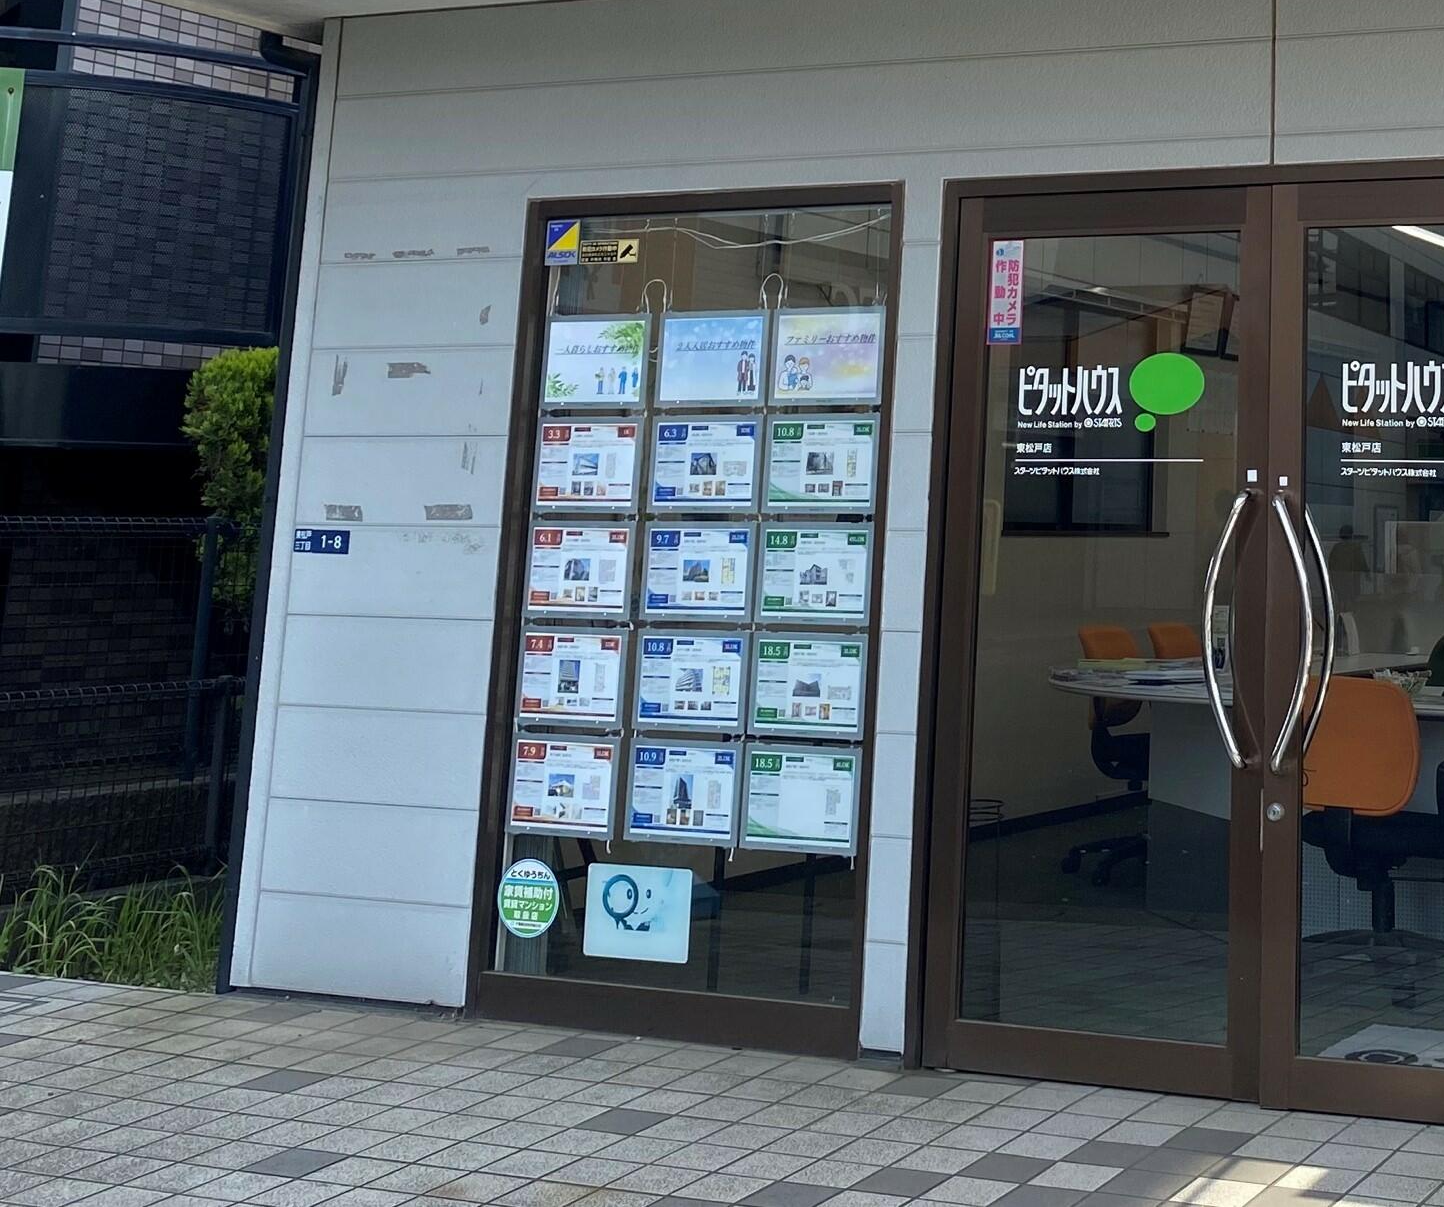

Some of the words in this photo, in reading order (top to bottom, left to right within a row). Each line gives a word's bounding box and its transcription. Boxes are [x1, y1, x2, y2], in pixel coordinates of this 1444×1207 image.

[993, 260, 1008, 326] 作動中
[1006, 260, 1020, 326] 防犯カメラ
[1018, 365, 1123, 416] ピタットハウス
[1018, 421, 1033, 429] New
[1033, 420, 1047, 429] Life
[1048, 420, 1073, 429] Station
[1074, 421, 1082, 430] by
[1342, 419, 1359, 428] New
[1360, 418, 1375, 428] Life
[1376, 418, 1403, 428] Station
[1405, 418, 1416, 429] by
[547, 429, 561, 439] 3.3
[664, 428, 677, 438] 6.3
[777, 427, 794, 437] 10.8
[1016, 443, 1052, 454] 東松戸店
[1341, 442, 1382, 454] 東松戸店
[321, 535, 342, 549] 1-8
[539, 533, 552, 543] 6.1
[656, 534, 670, 544] 9.7
[770, 535, 788, 545] 14.8
[763, 645, 781, 656] 18.5
[522, 746, 536, 756] 7.9
[639, 751, 657, 762] 10.9
[755, 757, 773, 768] 18.5
[504, 884, 553, 901] 家賃補助付
